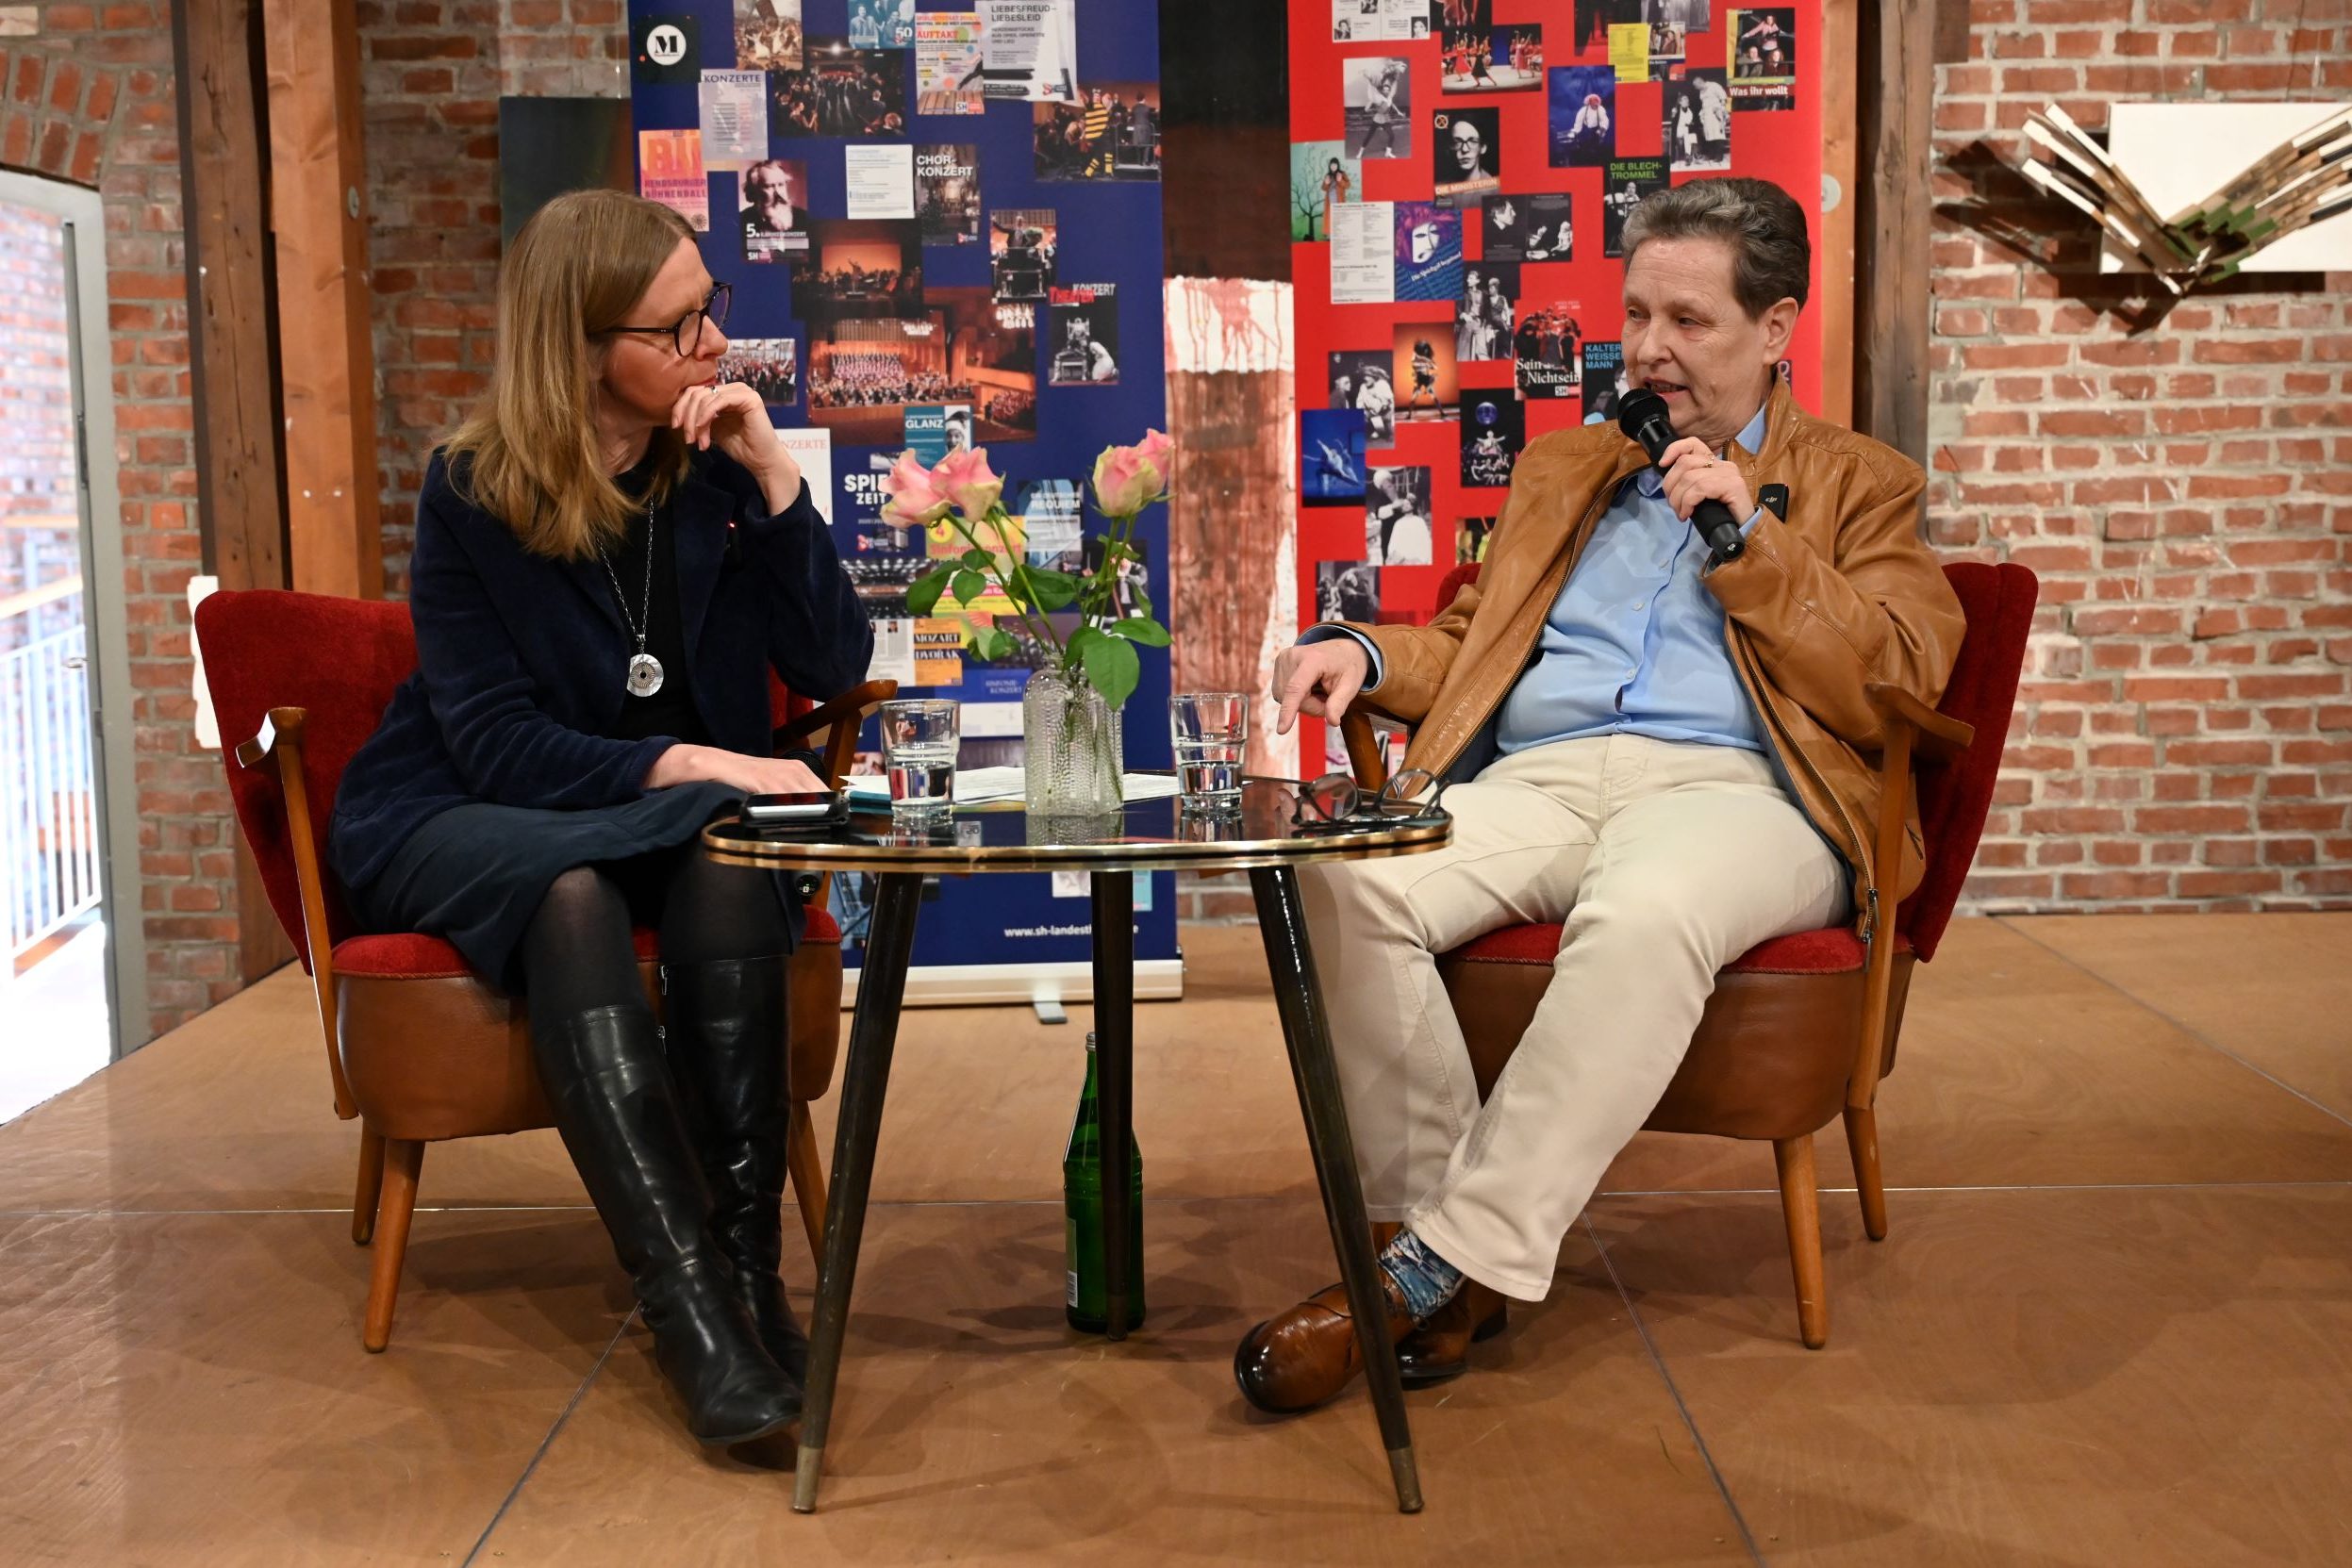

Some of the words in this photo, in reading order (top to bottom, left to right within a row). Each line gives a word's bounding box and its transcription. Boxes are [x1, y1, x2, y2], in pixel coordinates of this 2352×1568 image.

[917, 29, 959, 39] AUFTAKT
[654, 35, 678, 54] M
[704, 74, 762, 83] KONZERTE
[1730, 87, 1748, 96] Was
[1749, 86, 1764, 95] ihr
[1764, 85, 1788, 95] wollt
[916, 155, 957, 165] CHOR-
[916, 166, 973, 177] KONZERT
[1610, 162, 1626, 171] DIE
[1627, 161, 1663, 171] BLECH-
[1611, 171, 1658, 180] TROMMEL
[1435, 186, 1449, 195] DIE
[1450, 178, 1498, 191] MINISTERIN
[746, 223, 760, 238] 5.
[1072, 283, 1116, 296] KONZERT
[1585, 343, 1621, 352] KALTER
[1516, 357, 1541, 371] Sein
[1527, 371, 1580, 385] Nichtsein
[905, 419, 944, 429] GLANZ
[780, 438, 828, 450] NZERTE
[855, 492, 886, 505] ZEIT
[915, 634, 958, 642] MOZART
